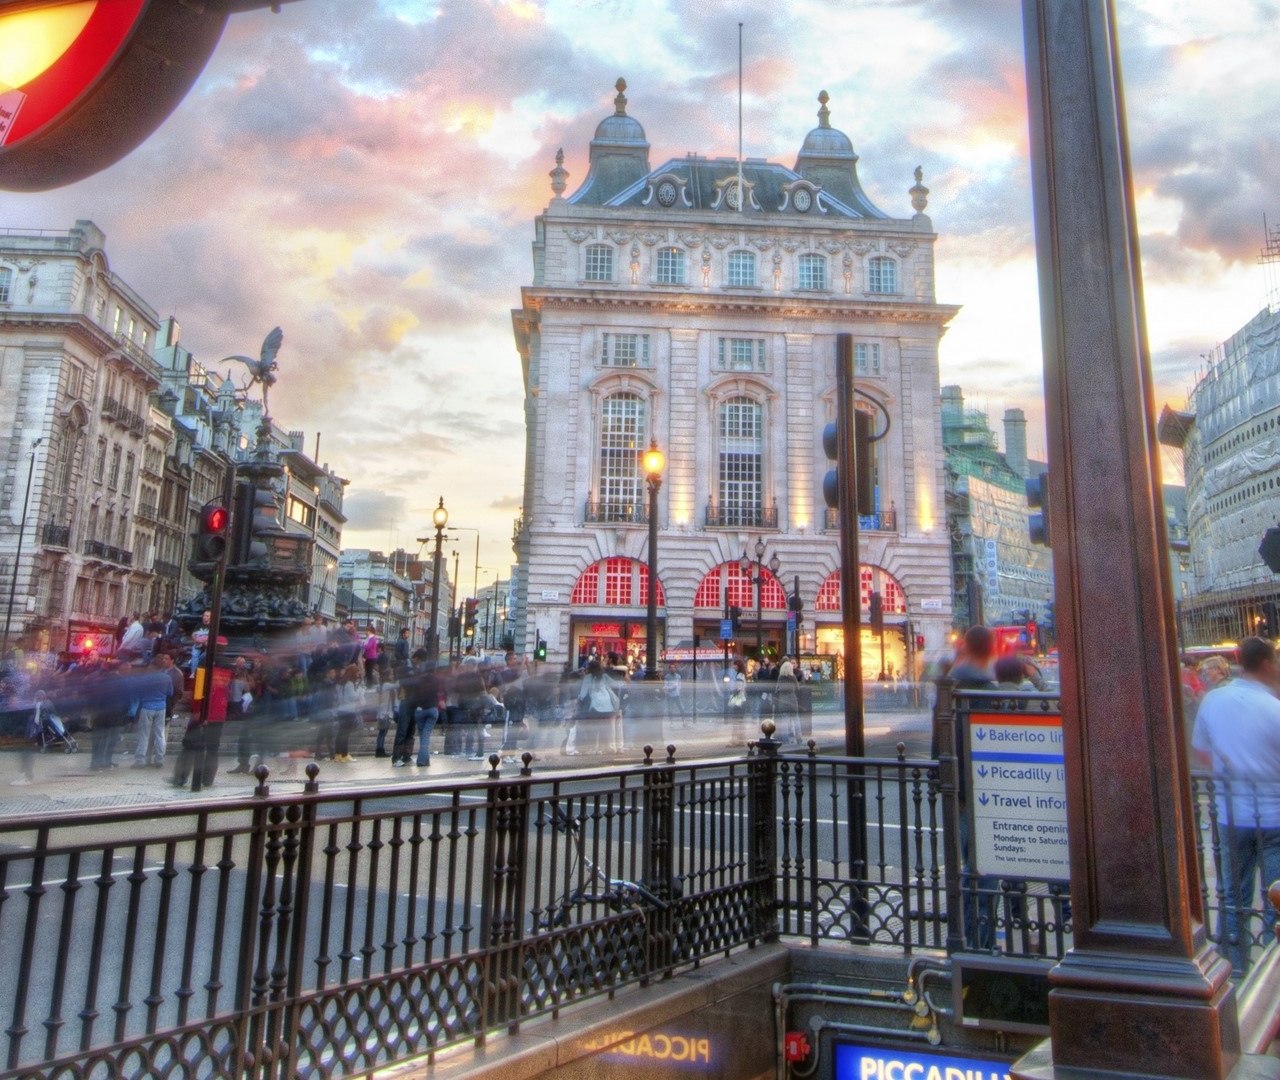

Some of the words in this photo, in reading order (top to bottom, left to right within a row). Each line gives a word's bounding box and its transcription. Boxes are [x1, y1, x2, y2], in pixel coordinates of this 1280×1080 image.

[989, 729, 1045, 742] Bakerloo
[991, 767, 1052, 783] Piccadilly
[992, 794, 1032, 808] Travel
[993, 821, 1033, 831] Entrance
[993, 834, 1026, 844] Mondays
[1028, 836, 1037, 844] to
[994, 843, 1026, 853] Sundays:
